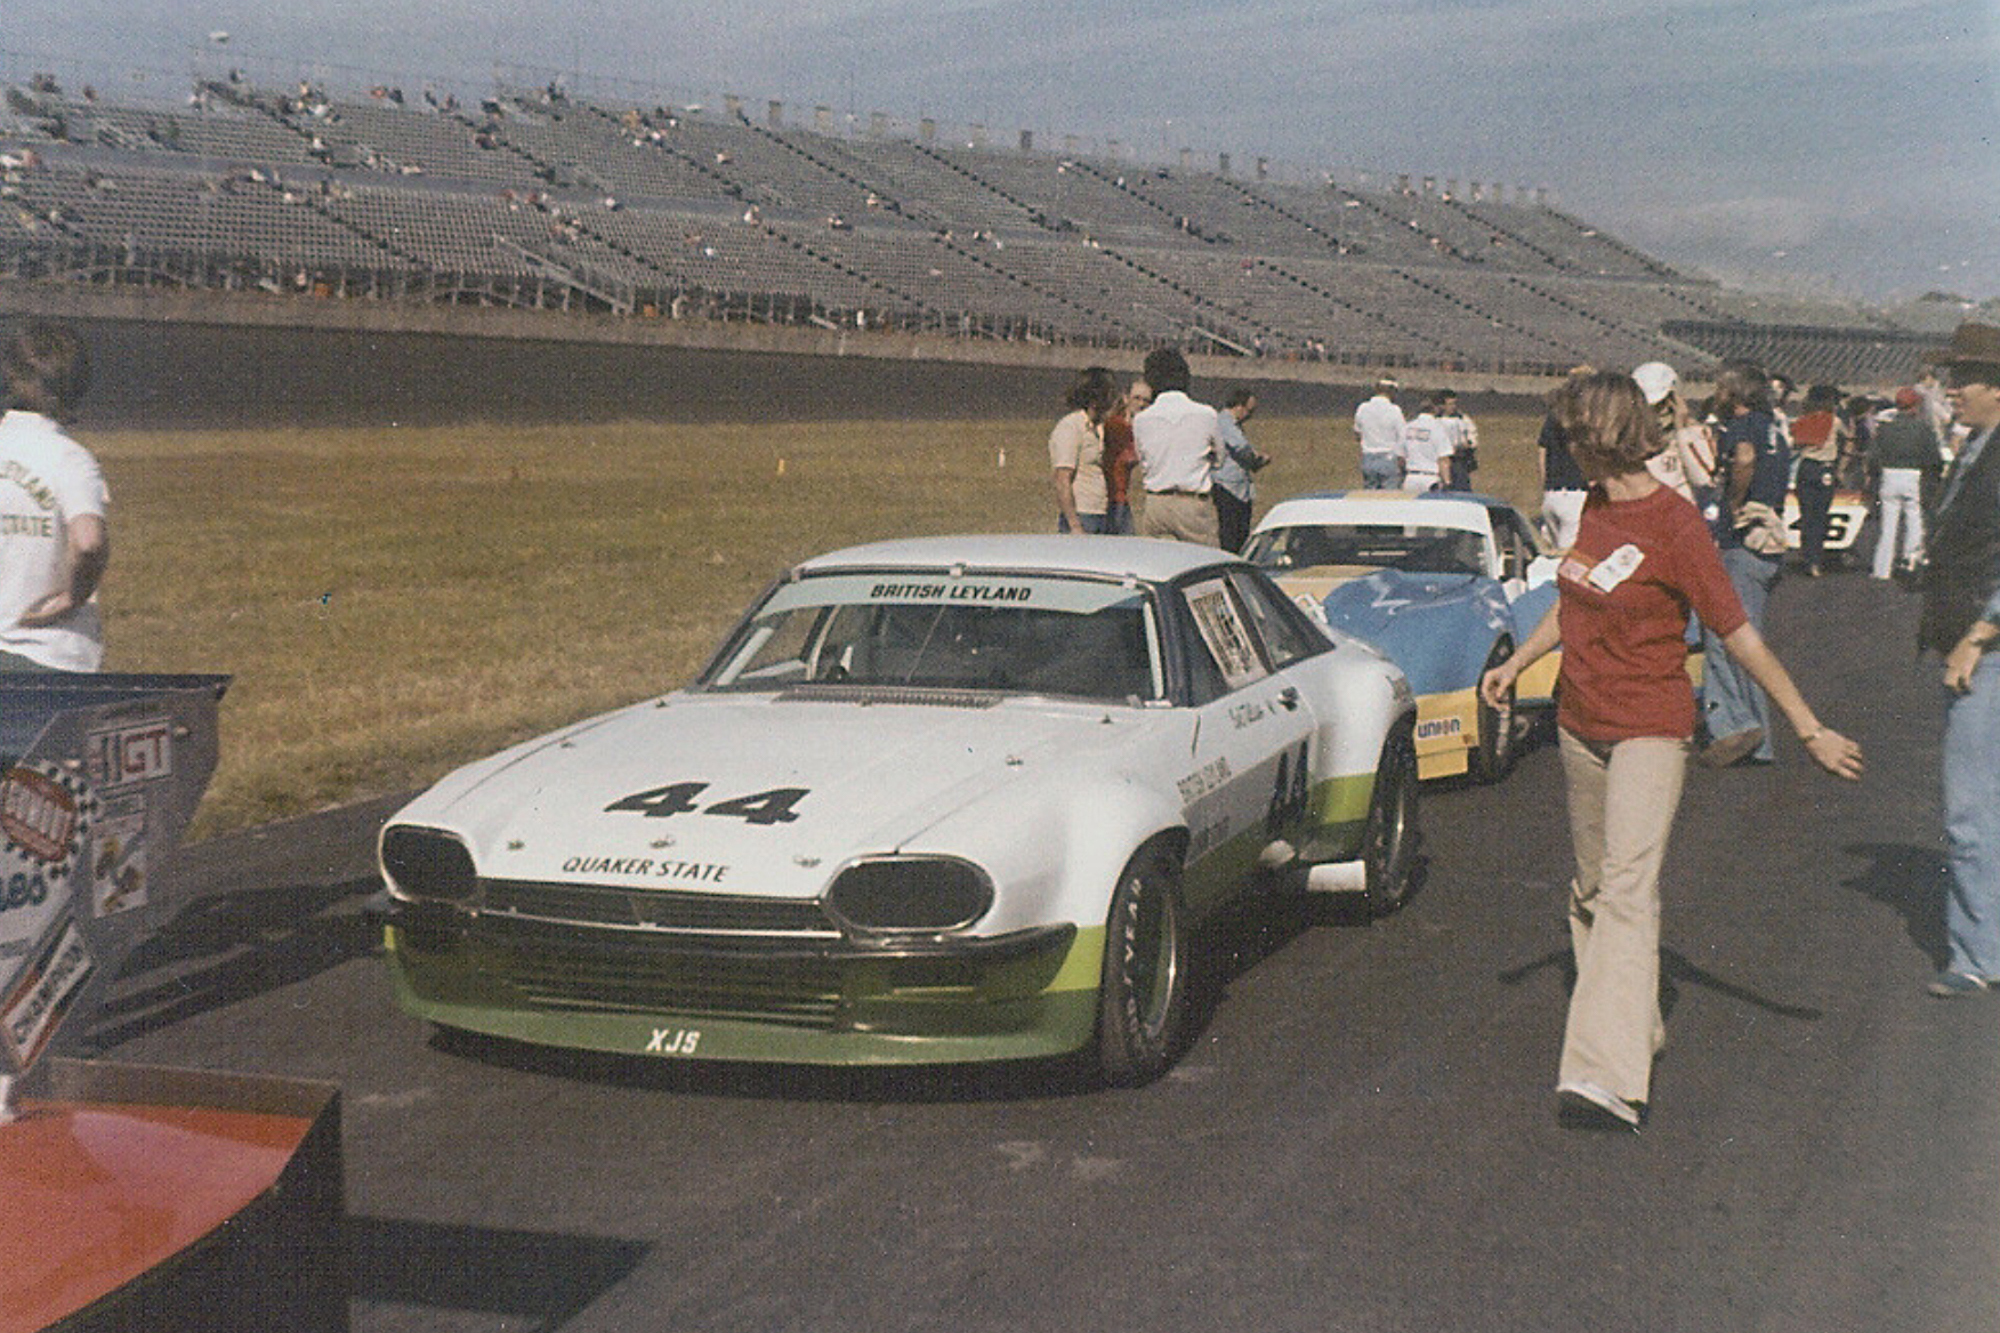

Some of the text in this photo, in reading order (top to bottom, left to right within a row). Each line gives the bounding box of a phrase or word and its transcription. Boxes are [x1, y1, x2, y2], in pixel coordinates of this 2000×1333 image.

[870, 584, 1032, 601] BRITISH LEYLAND
[603, 782, 812, 825] 44
[561, 857, 730, 883] QUAKER STATE
[645, 1028, 701, 1054] XJS
